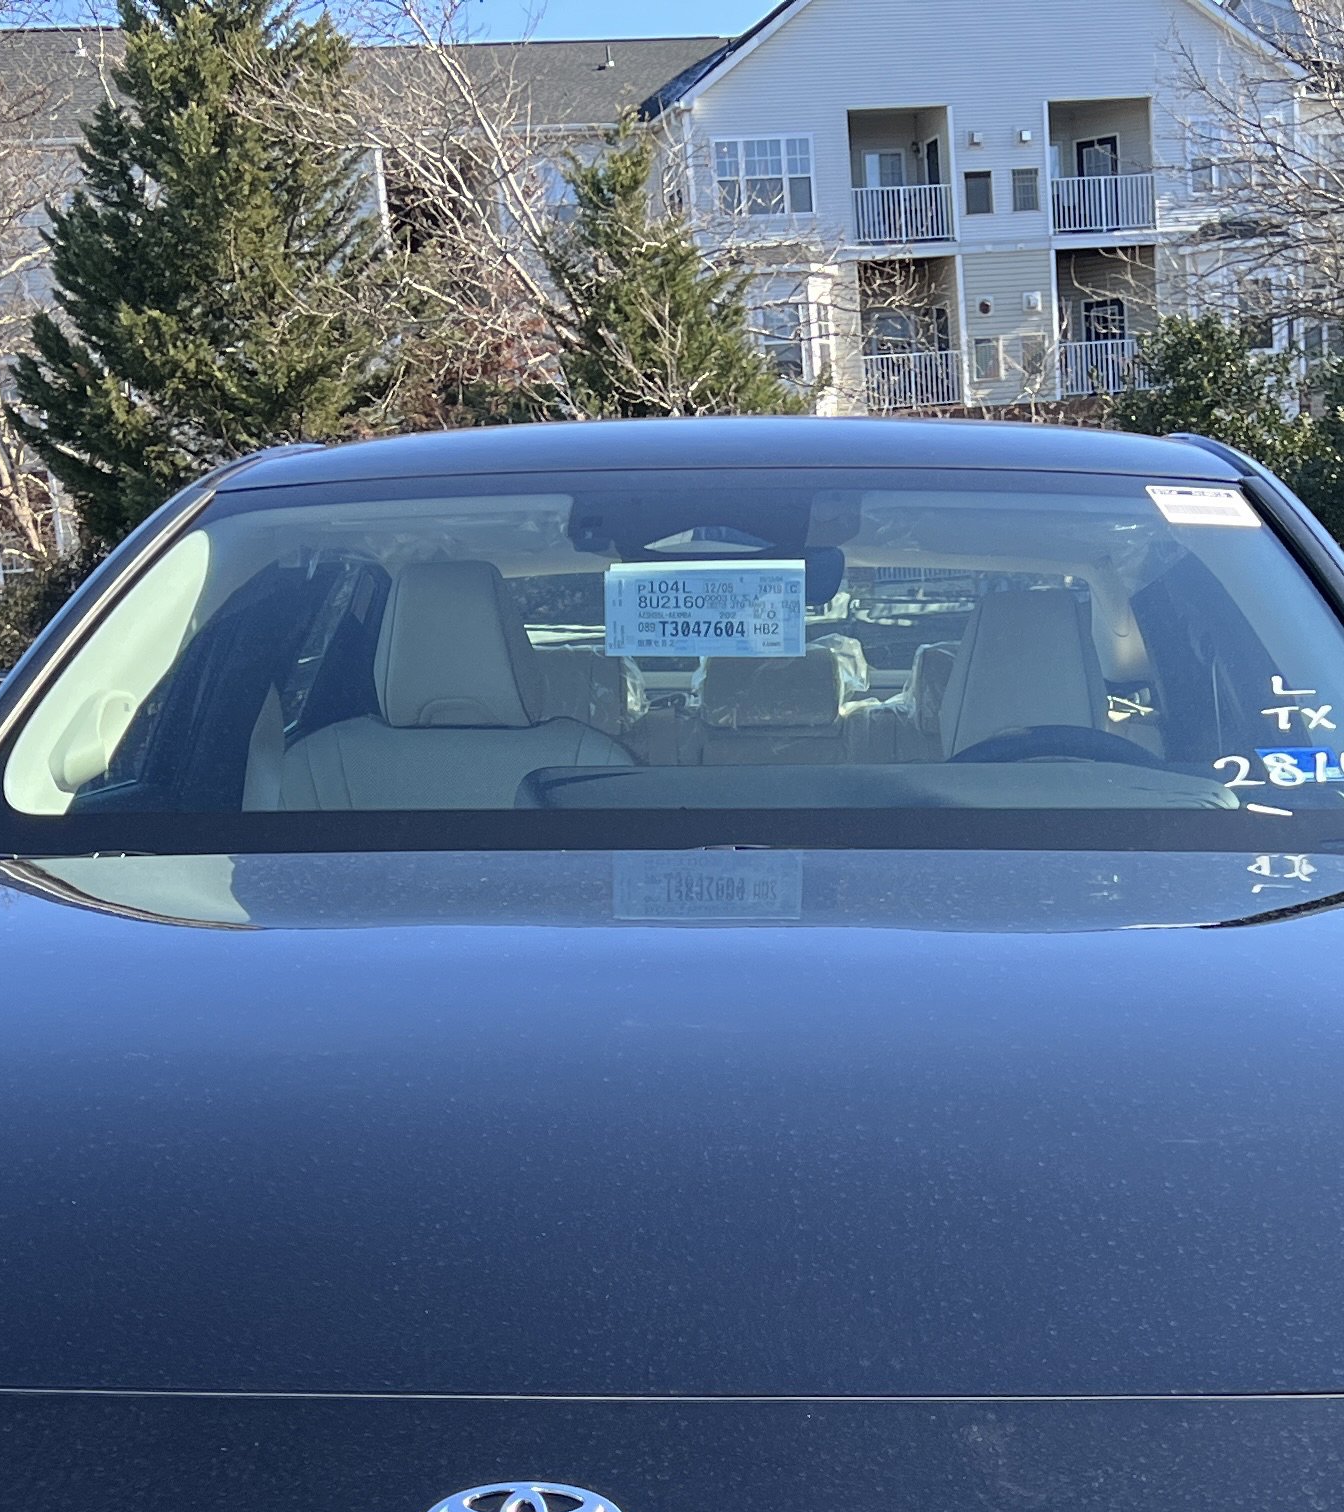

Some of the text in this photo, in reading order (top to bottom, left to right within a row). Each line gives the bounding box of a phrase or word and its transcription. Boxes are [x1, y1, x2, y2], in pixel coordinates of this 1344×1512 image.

[637, 580, 692, 594] P104L
[789, 583, 799, 594] C
[637, 595, 705, 609] 8U2160
[658, 620, 746, 638] T3047604
[753, 622, 779, 635] HB2
[1271, 675, 1317, 697] L
[1261, 704, 1336, 731] TX
